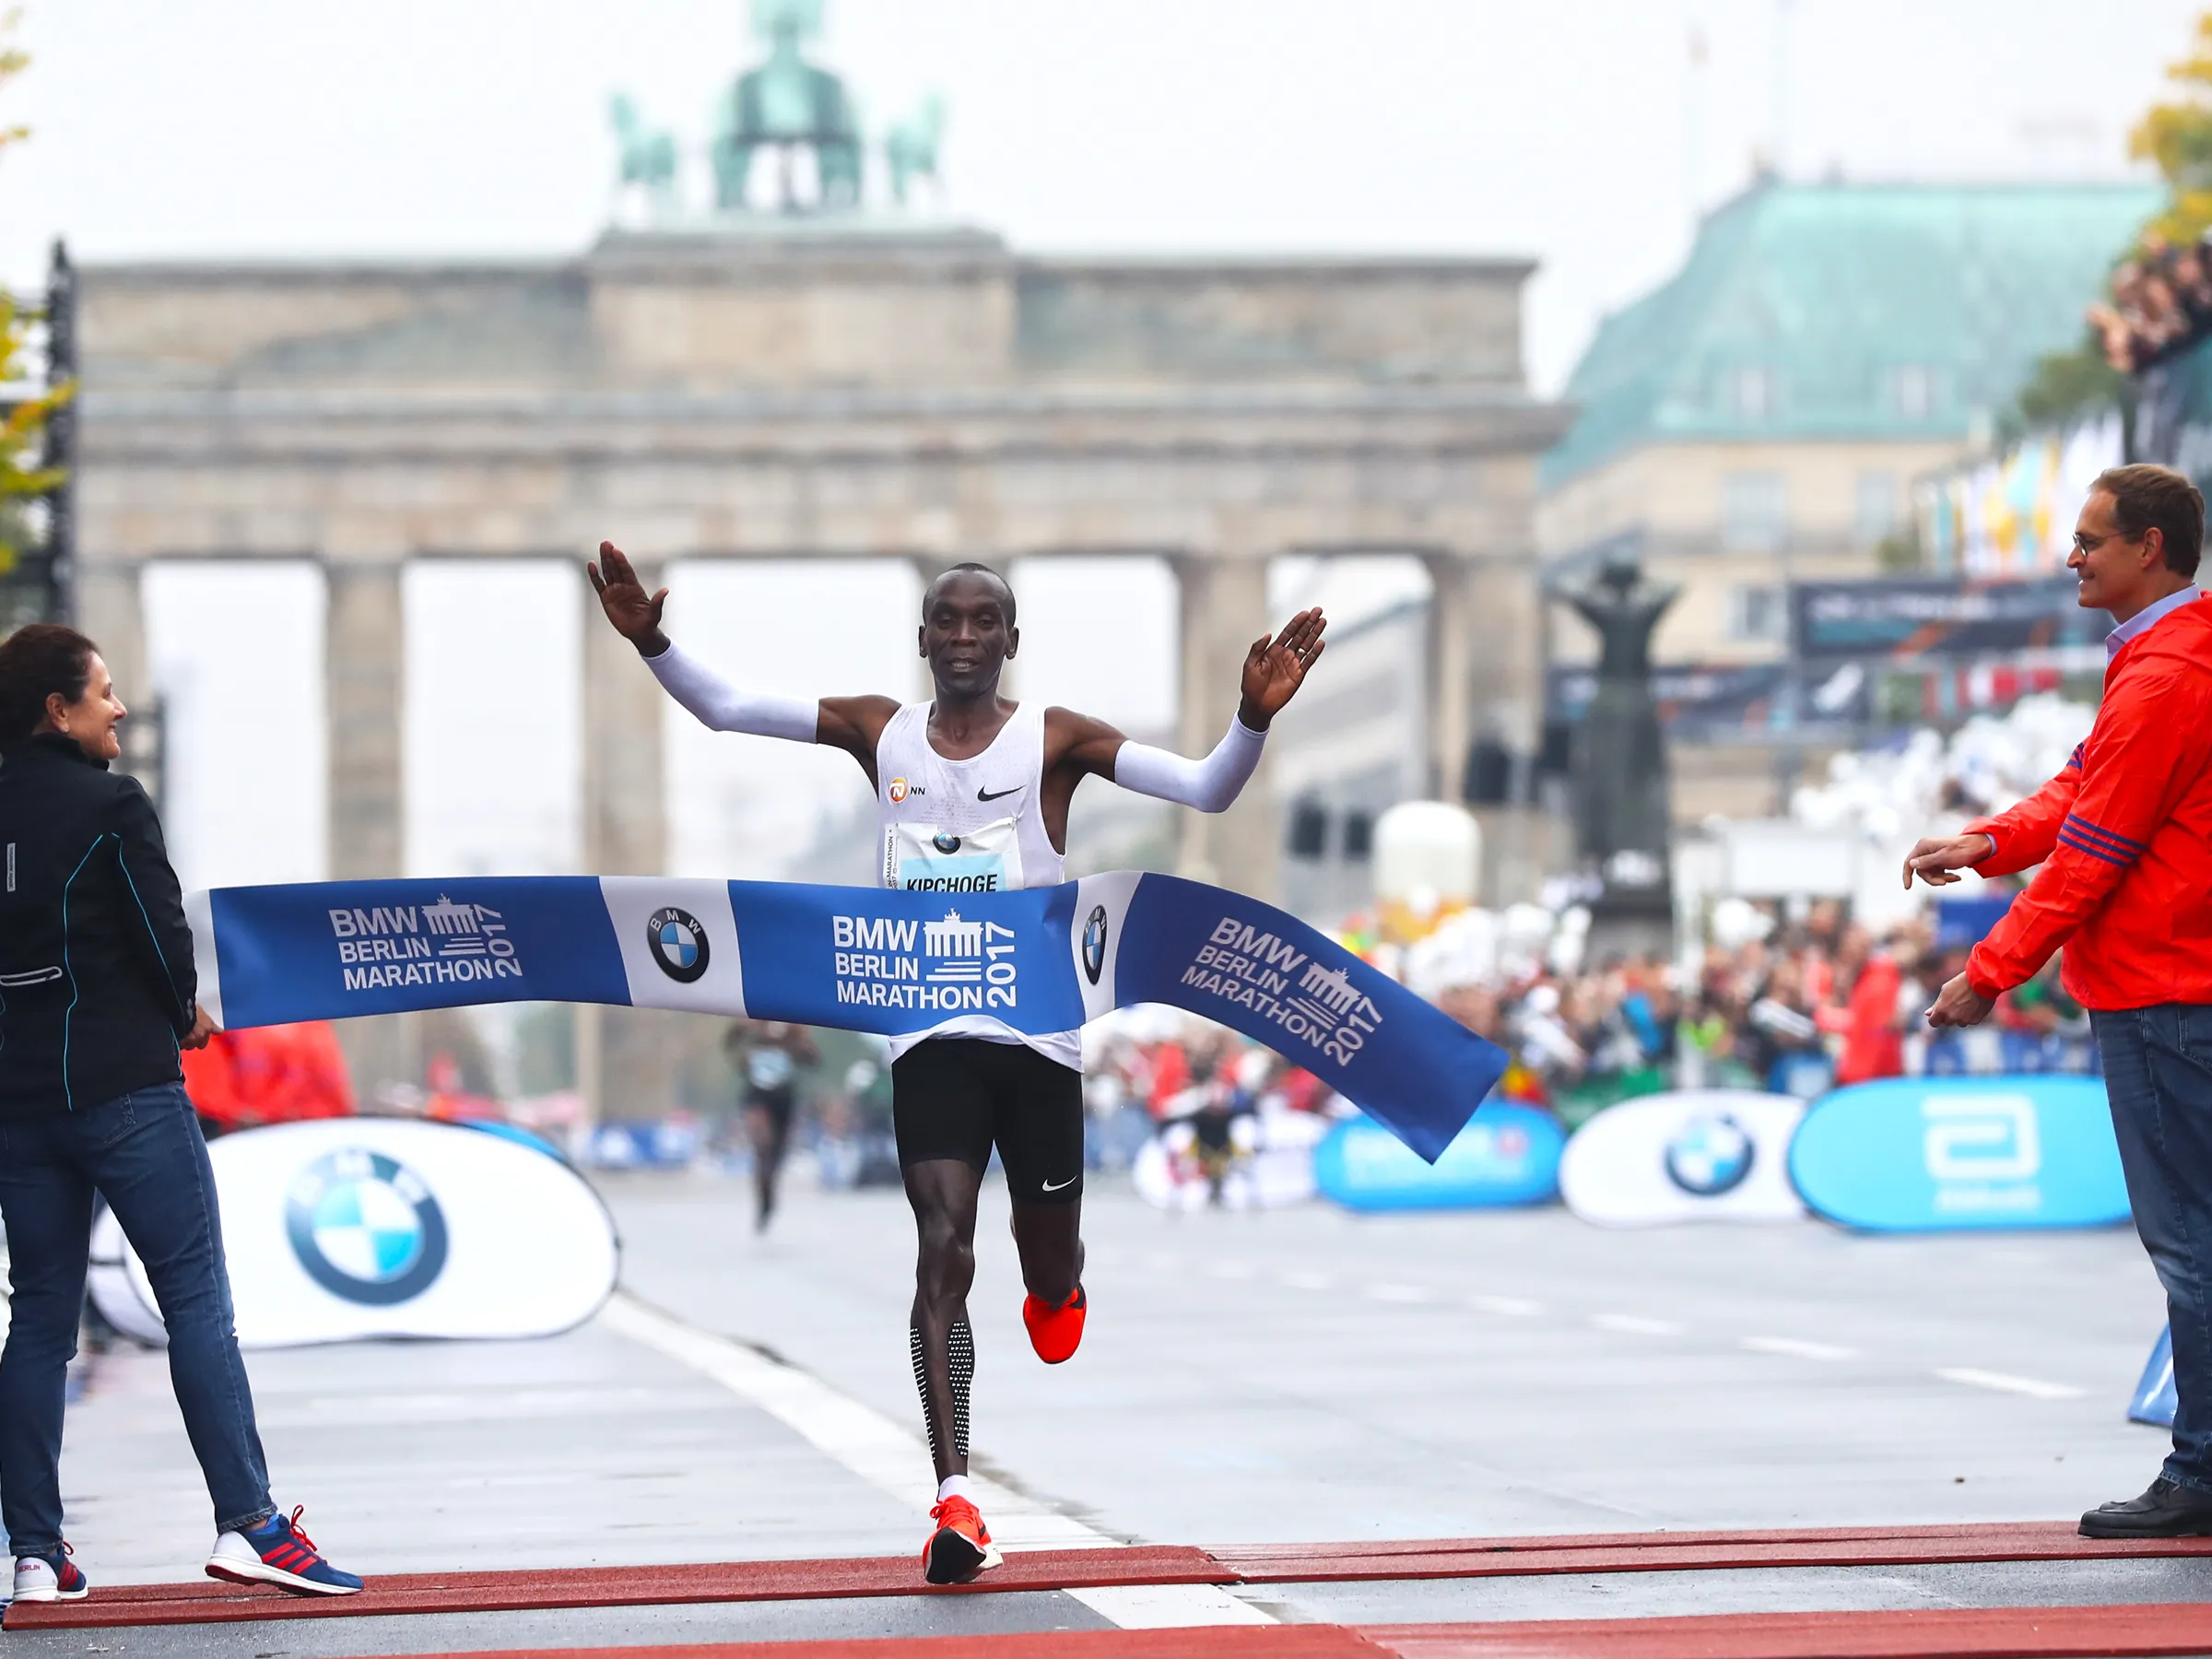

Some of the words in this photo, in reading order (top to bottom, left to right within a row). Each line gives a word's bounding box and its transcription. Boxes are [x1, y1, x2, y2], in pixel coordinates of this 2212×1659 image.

[910, 786, 925, 795] NN
[907, 874, 997, 892] KIPCHOGE
[329, 906, 418, 936] BMW
[651, 910, 701, 934] BMW
[832, 915, 918, 952] BMW
[338, 937, 431, 963] BERLIN
[473, 904, 524, 978] 2017
[1209, 917, 1309, 972] BMW
[344, 959, 494, 991] MARATHON
[834, 952, 919, 981] BERLIN
[985, 921, 1017, 1008] 2017
[1194, 945, 1289, 995] BERLIN
[836, 980, 982, 1010] MARATHON
[1181, 966, 1327, 1048] MARATHON
[1324, 996, 1382, 1066] 2017
